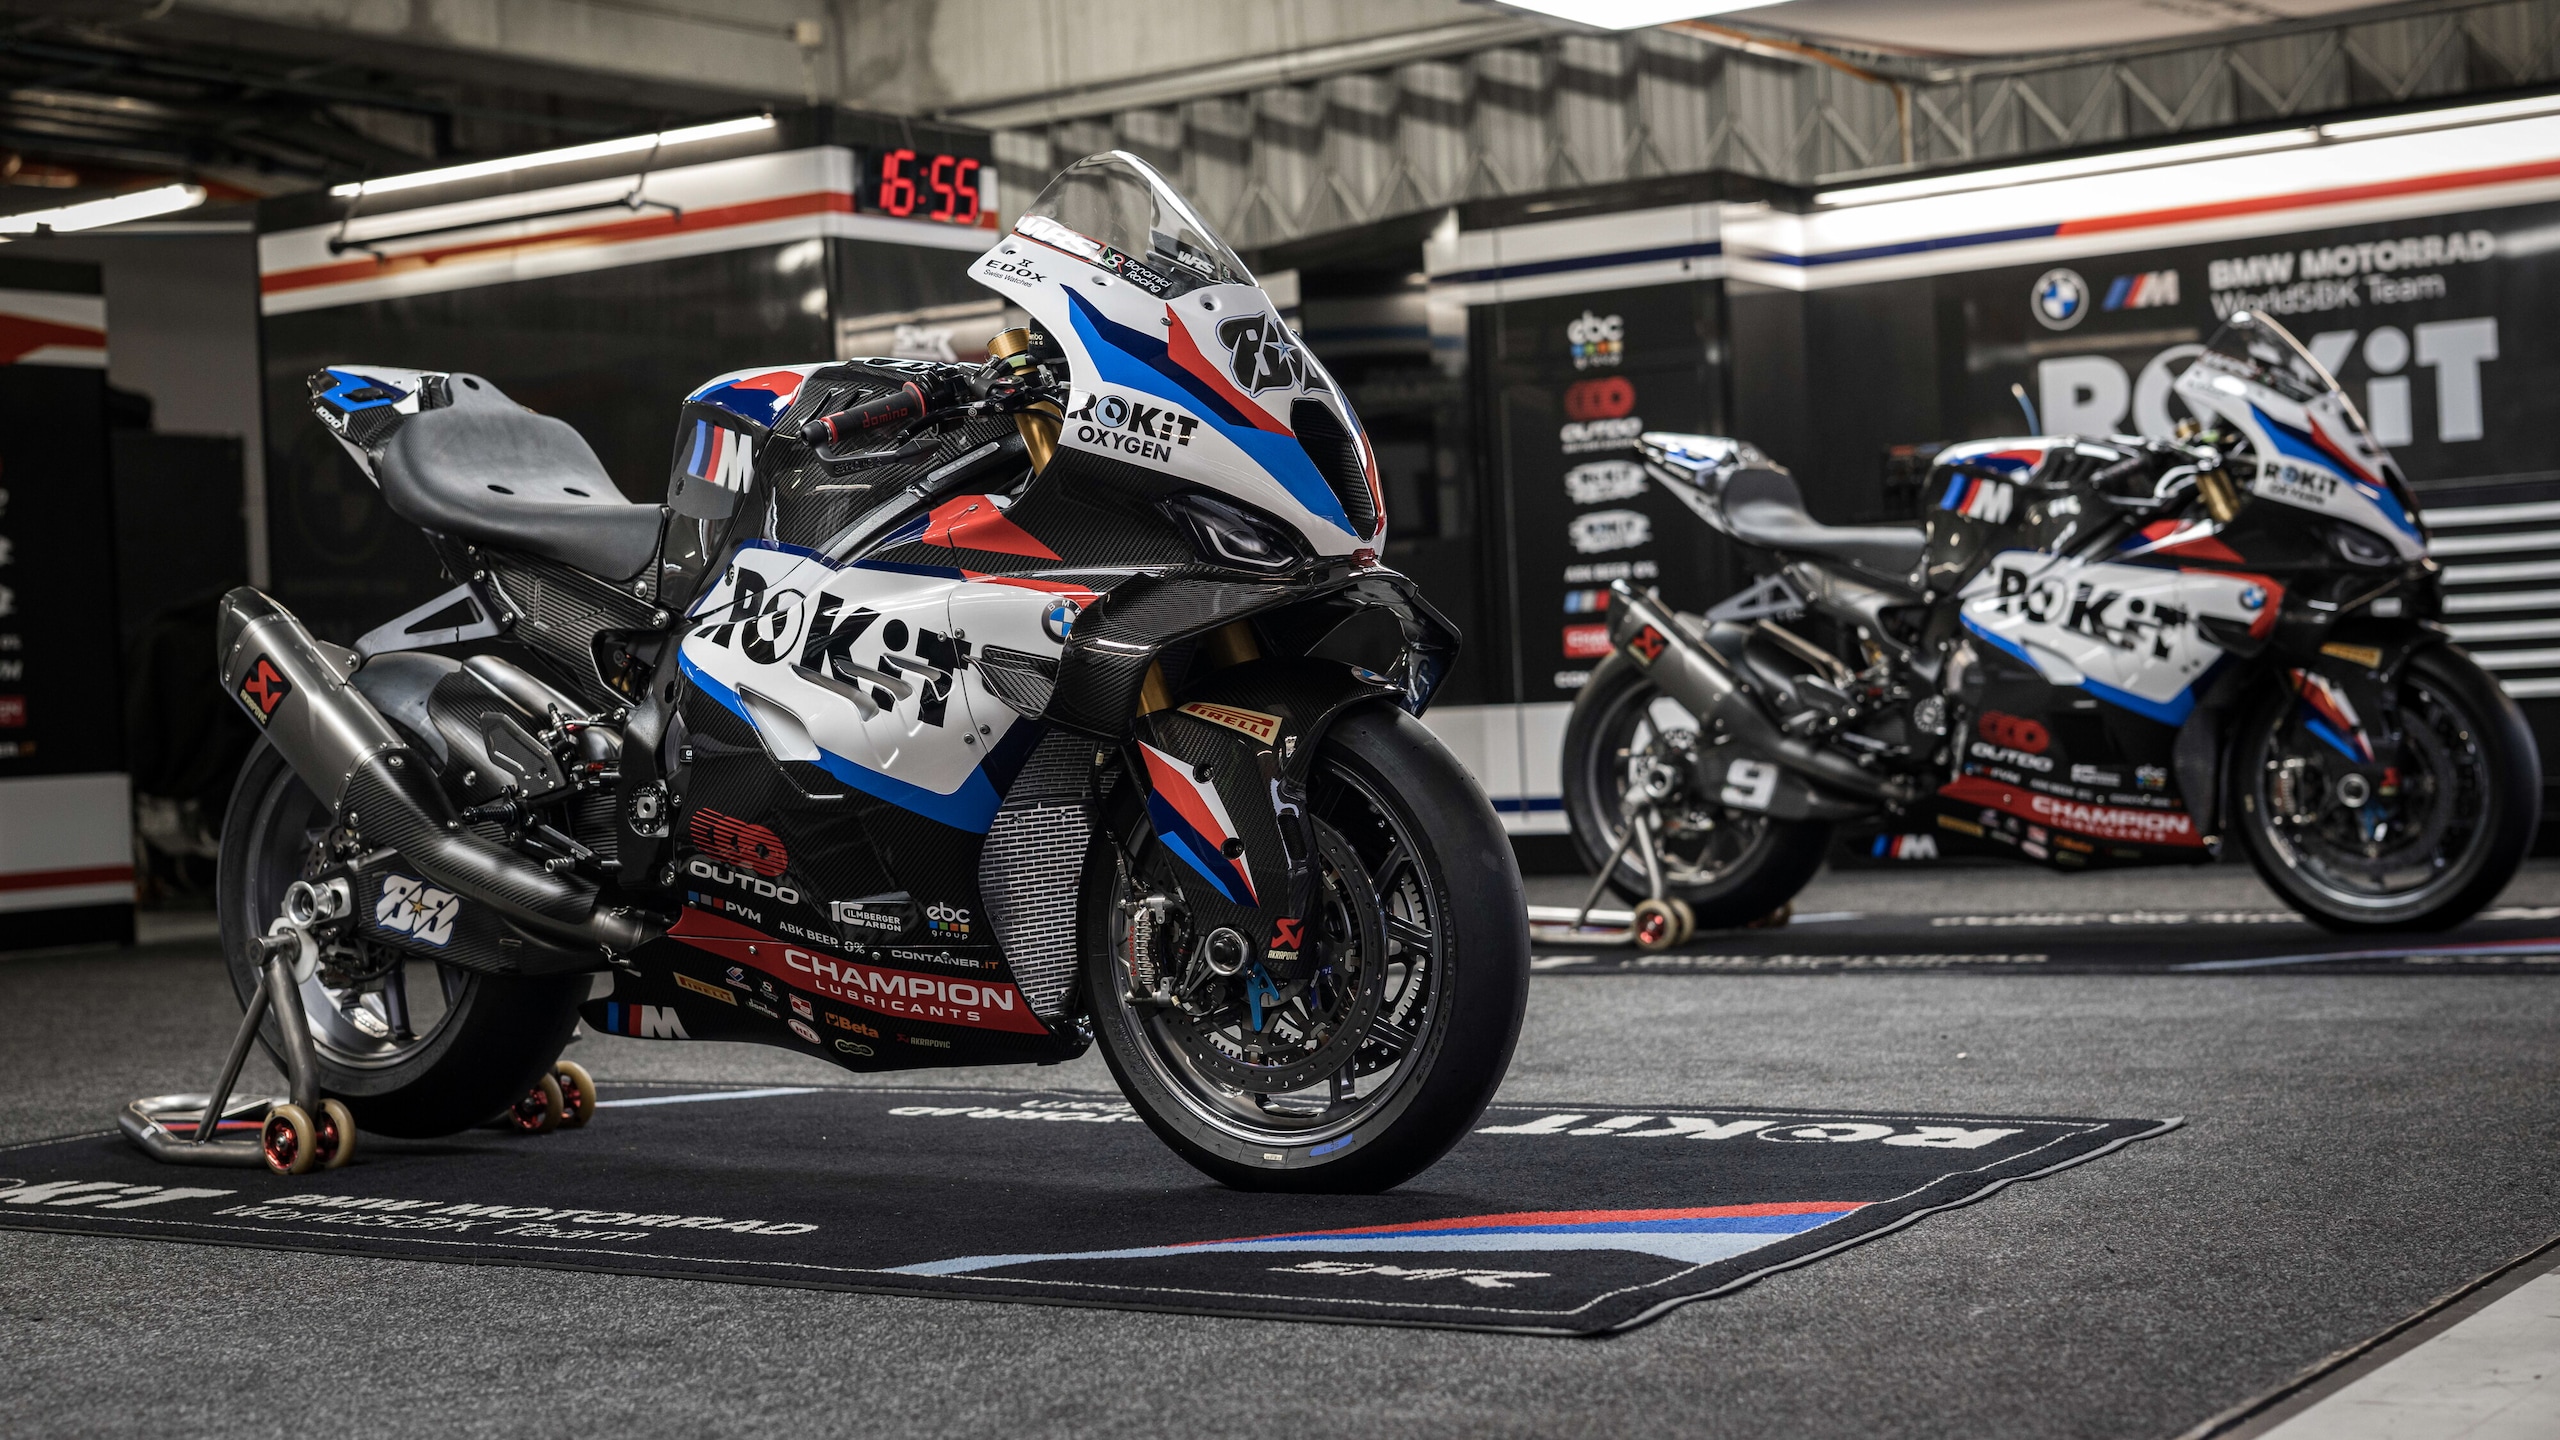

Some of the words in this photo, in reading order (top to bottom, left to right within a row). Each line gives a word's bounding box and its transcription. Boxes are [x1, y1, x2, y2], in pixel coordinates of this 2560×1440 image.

[880, 149, 979, 223] 16:55
[986, 259, 1047, 283] EDOX
[2208, 252, 2294, 290] BMW
[2302, 230, 2498, 278] MOTORRAD
[984, 269, 1003, 279] Swiss
[1004, 274, 1032, 288] Watches
[1126, 270, 1161, 293] Racing
[2211, 280, 2361, 323] WorldSBK
[2364, 271, 2446, 304] Team
[316, 405, 342, 429] 1000
[862, 404, 909, 430] domino
[1077, 425, 1172, 463] OXYGEN
[713, 430, 754, 494] M
[1186, 703, 1274, 738] PIRELLI
[1721, 758, 1779, 810] 9
[2032, 795, 2190, 834] CHAMPION
[690, 859, 799, 905] OUTDO
[376, 874, 460, 946] 88
[725, 899, 762, 924] PVM
[926, 901, 971, 923] ebc
[779, 921, 805, 937] ABK
[806, 928, 838, 948] BEER
[844, 940, 866, 955] 0%
[931, 930, 968, 941] group
[679, 976, 732, 1003] PIRELLI
[785, 948, 1014, 1011] CHAMPION
[814, 979, 981, 1022] LUBRICANTS
[641, 1005, 691, 1039] M
[838, 1016, 880, 1040] Beta
[262, 1193, 442, 1211] BMW
[432, 1203, 819, 1236] MOTORRAD
[495, 1221, 653, 1241] Team
